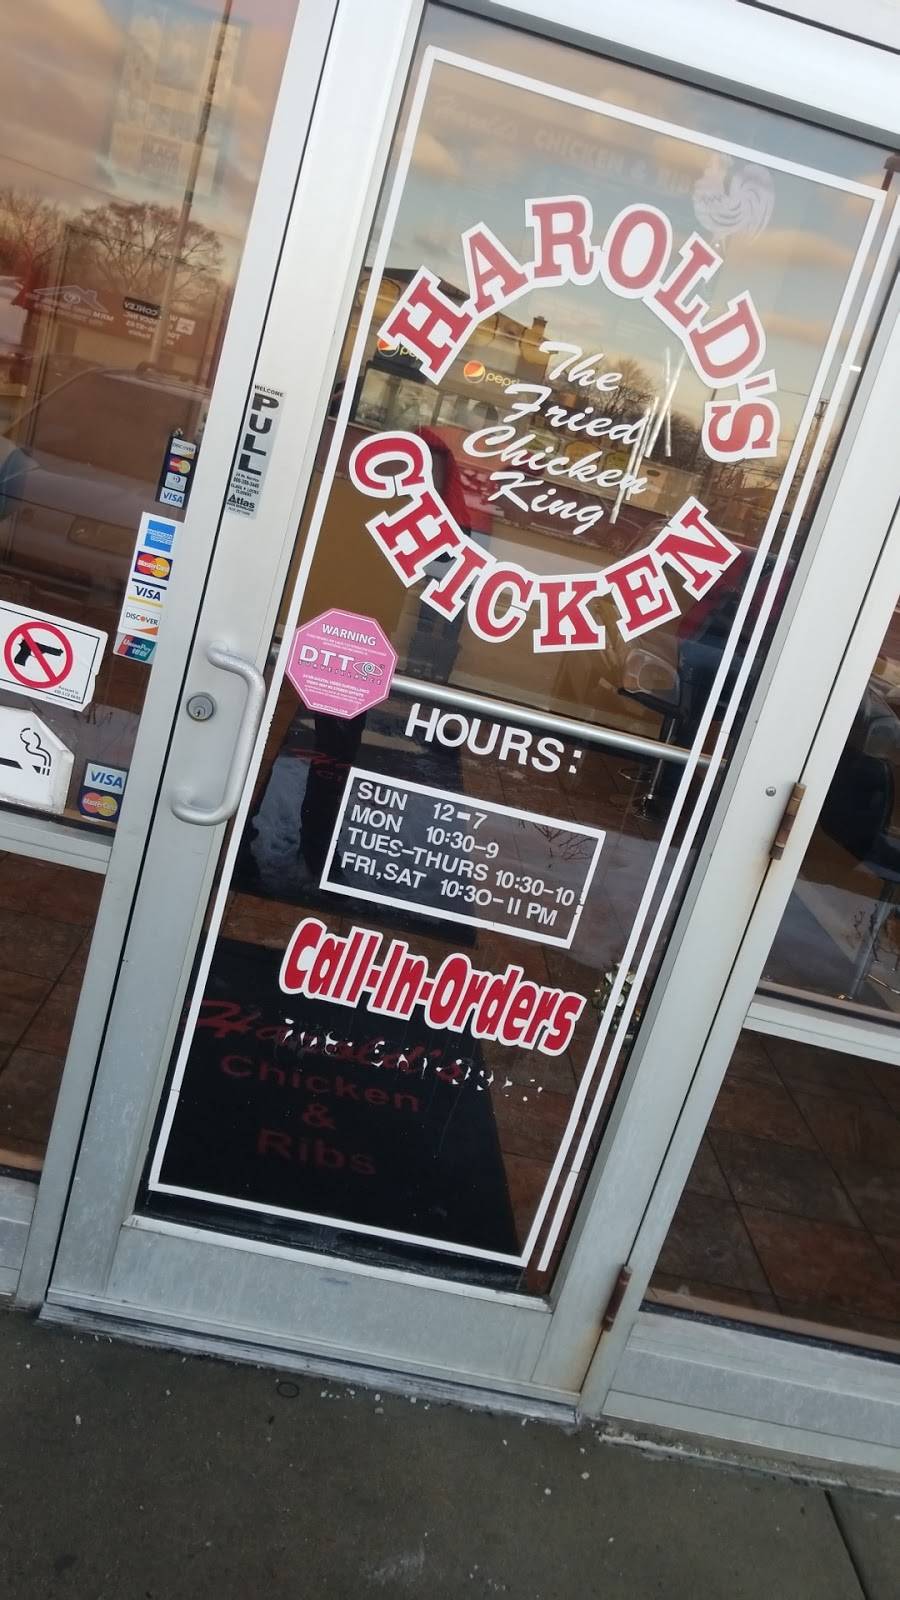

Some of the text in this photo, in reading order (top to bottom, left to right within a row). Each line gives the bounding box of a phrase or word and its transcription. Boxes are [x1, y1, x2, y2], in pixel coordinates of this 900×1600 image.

[380, 195, 779, 462] HAROLD'S
[255, 384, 284, 397] WELCOME
[539, 341, 623, 391] The
[238, 392, 279, 476] PULL
[504, 384, 649, 445] Fried
[463, 426, 649, 494] Chicken
[163, 492, 182, 503] VISA
[228, 493, 255, 509] Atlas
[488, 471, 604, 535] King
[350, 432, 740, 653] CHICKEN
[125, 611, 158, 626] DISCOVER
[135, 585, 161, 601] VISA
[300, 645, 355, 671] DTT
[322, 623, 376, 646] WARNING
[405, 702, 583, 774] HOURS:
[91, 771, 123, 789] VISA
[357, 781, 488, 830] SUN 12-7
[351, 804, 499, 859] MON 10:30-9
[341, 852, 427, 889] FRI,SAT
[526, 904, 558, 927] PM
[348, 827, 575, 906] TUES-THURS 10:30-10
[279, 918, 587, 1056] Call-In-Orders
[221, 1053, 419, 1113] Chicken
[301, 1104, 337, 1130] &
[257, 1127, 377, 1176] Ribs
